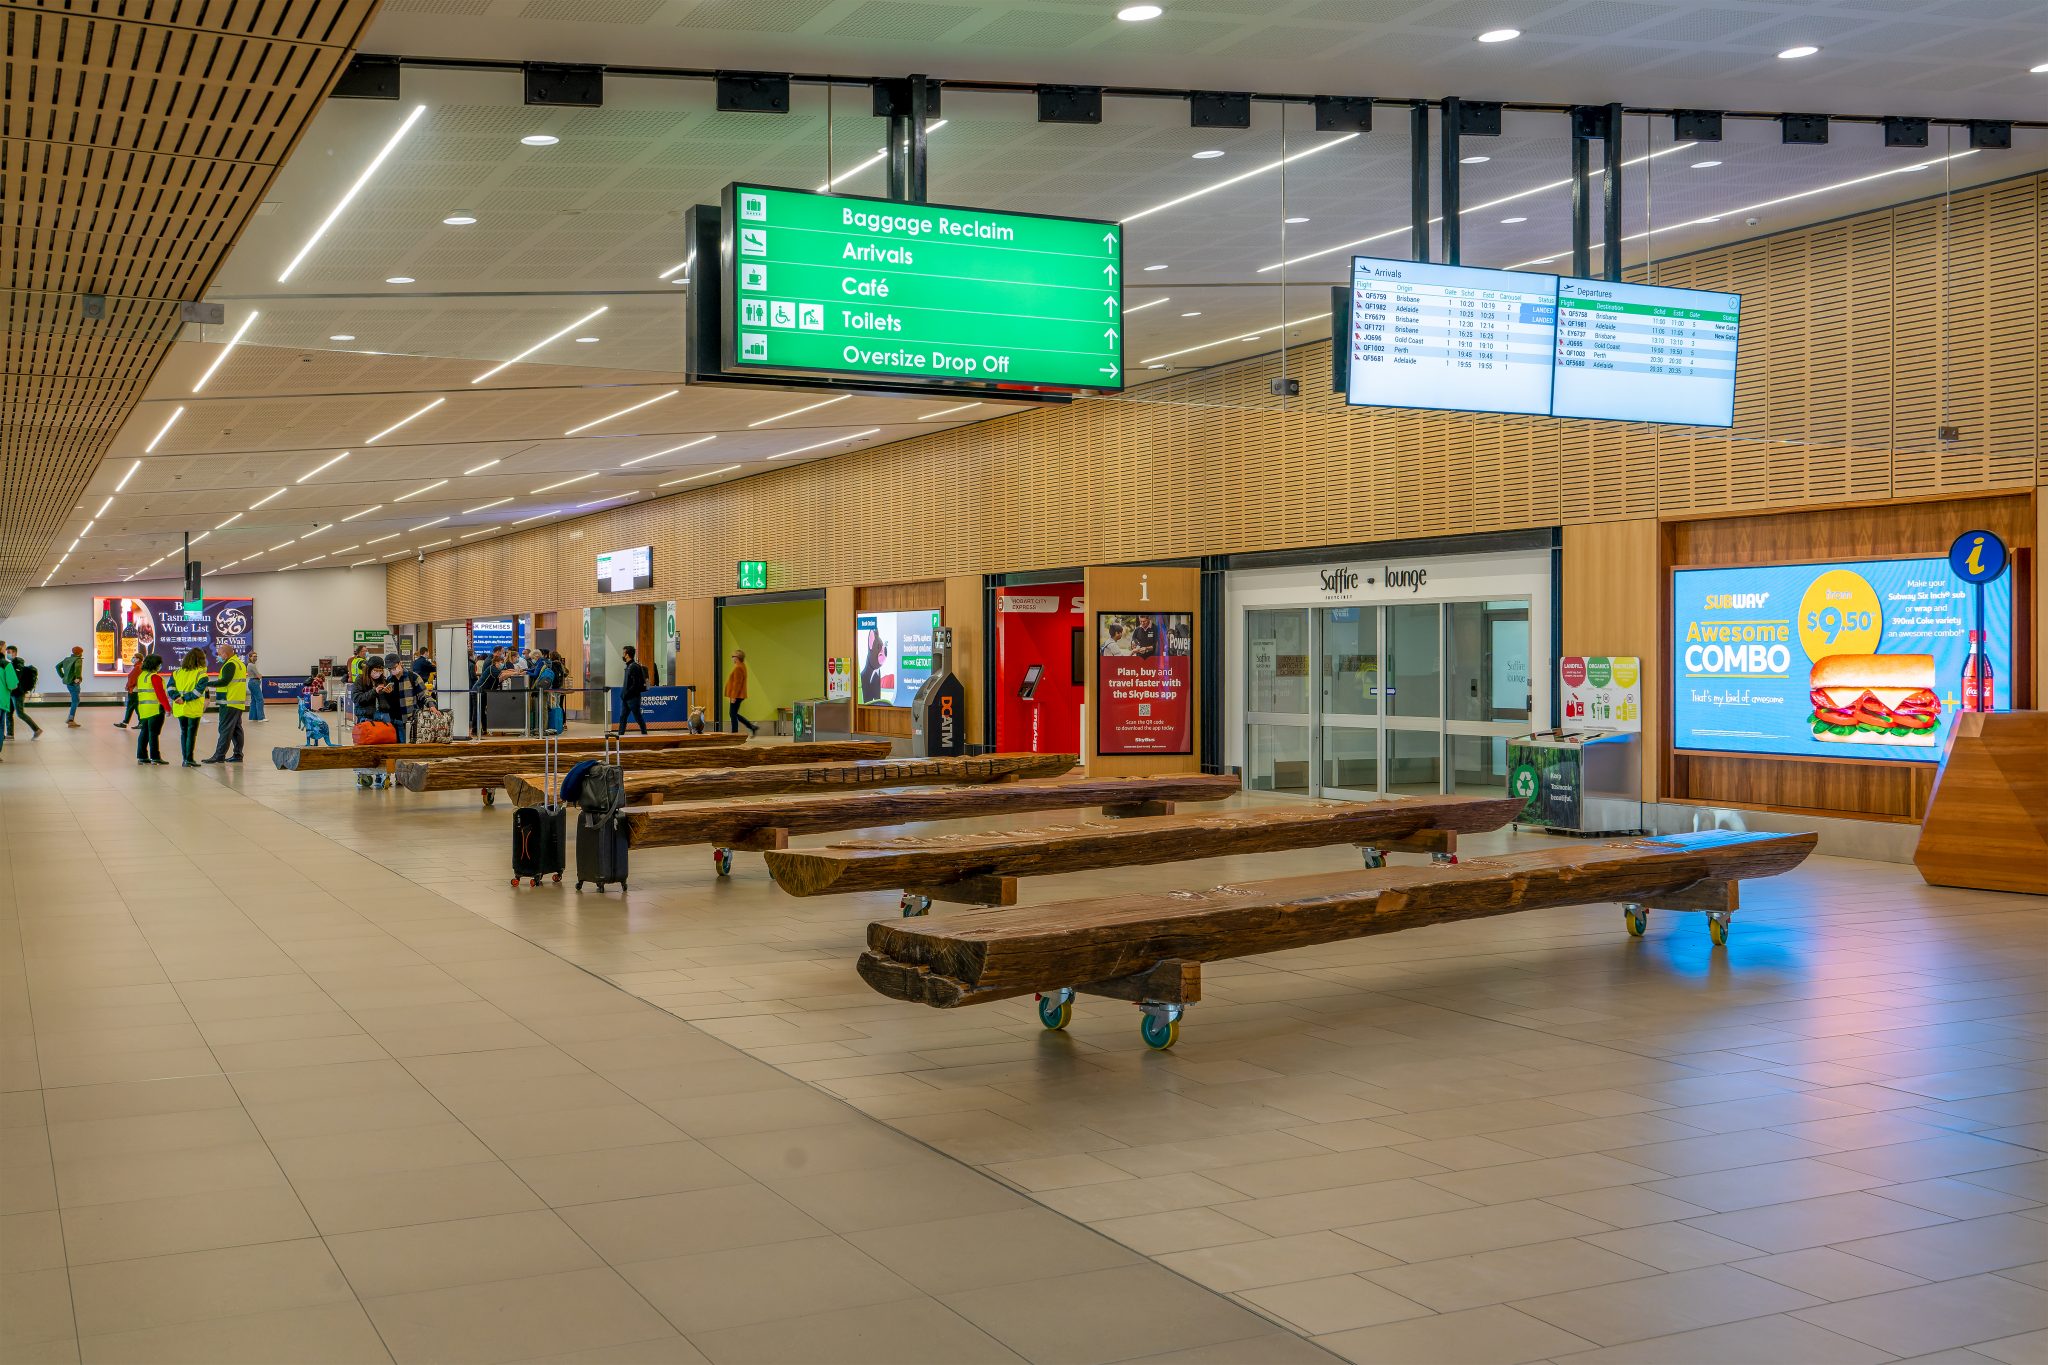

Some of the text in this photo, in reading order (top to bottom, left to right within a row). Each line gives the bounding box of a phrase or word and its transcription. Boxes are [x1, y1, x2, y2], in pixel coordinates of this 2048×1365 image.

[842, 208, 1014, 240] Baggage Reclaim
[842, 242, 913, 264] Arrivals
[1375, 269, 1402, 278] Arrivals
[842, 277, 889, 297] Café
[1578, 288, 1612, 298] Departures
[1597, 303, 1624, 311] Destination
[842, 310, 902, 332] Toilets
[843, 346, 1010, 374] Oversize Drop Off
[1140, 574, 1150, 601] i
[1320, 566, 1426, 594] Saffire lounge
[1928, 580, 1946, 589] your
[1704, 592, 1770, 610] SUBWAY
[1888, 592, 1916, 601] Subway
[162, 624, 209, 632] Wine List
[1936, 617, 1962, 626] variety
[1686, 621, 1789, 642] Awesome
[1684, 644, 1790, 673] COMBO
[1117, 668, 1138, 677] Plan,
[1140, 668, 1156, 678] buy
[1113, 690, 1177, 700] the SkyBus app
[1691, 690, 1784, 707] That's my kind of awesome
